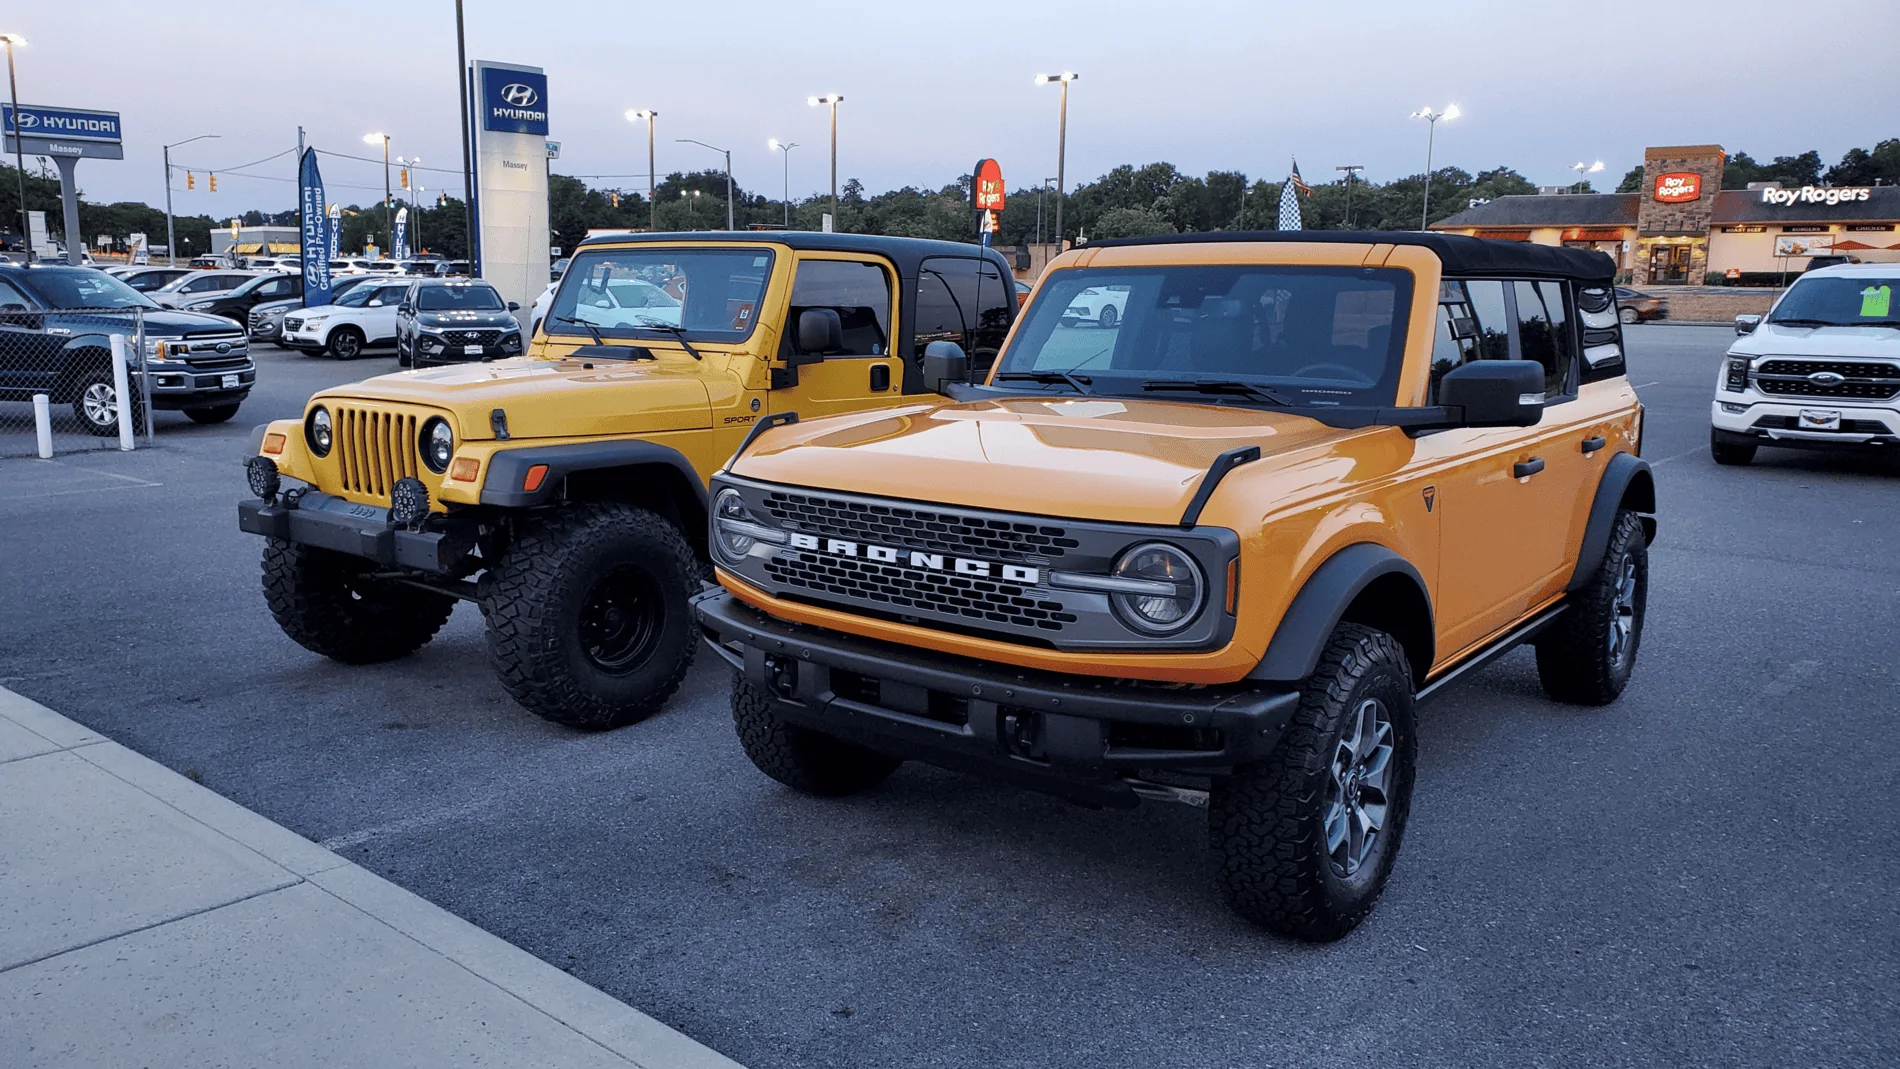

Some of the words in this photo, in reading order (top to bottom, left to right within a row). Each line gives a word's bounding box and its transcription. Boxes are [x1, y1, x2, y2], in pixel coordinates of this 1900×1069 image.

[493, 107, 546, 122] HYUNDAI
[43, 116, 116, 132] HYUNDAI
[49, 143, 83, 155] Massey
[503, 160, 528, 171] Massey
[1665, 177, 1685, 187] Roy
[1658, 185, 1695, 197] Rogers
[1763, 187, 1800, 206] Roy
[1801, 186, 1870, 205] Rogers
[304, 186, 317, 259] HYUNDAI
[314, 187, 324, 245] Pre-Owned
[395, 223, 405, 259] HYUND
[317, 246, 329, 290] Certified
[724, 415, 757, 424] SPORT
[790, 533, 1039, 583] BRONCO
